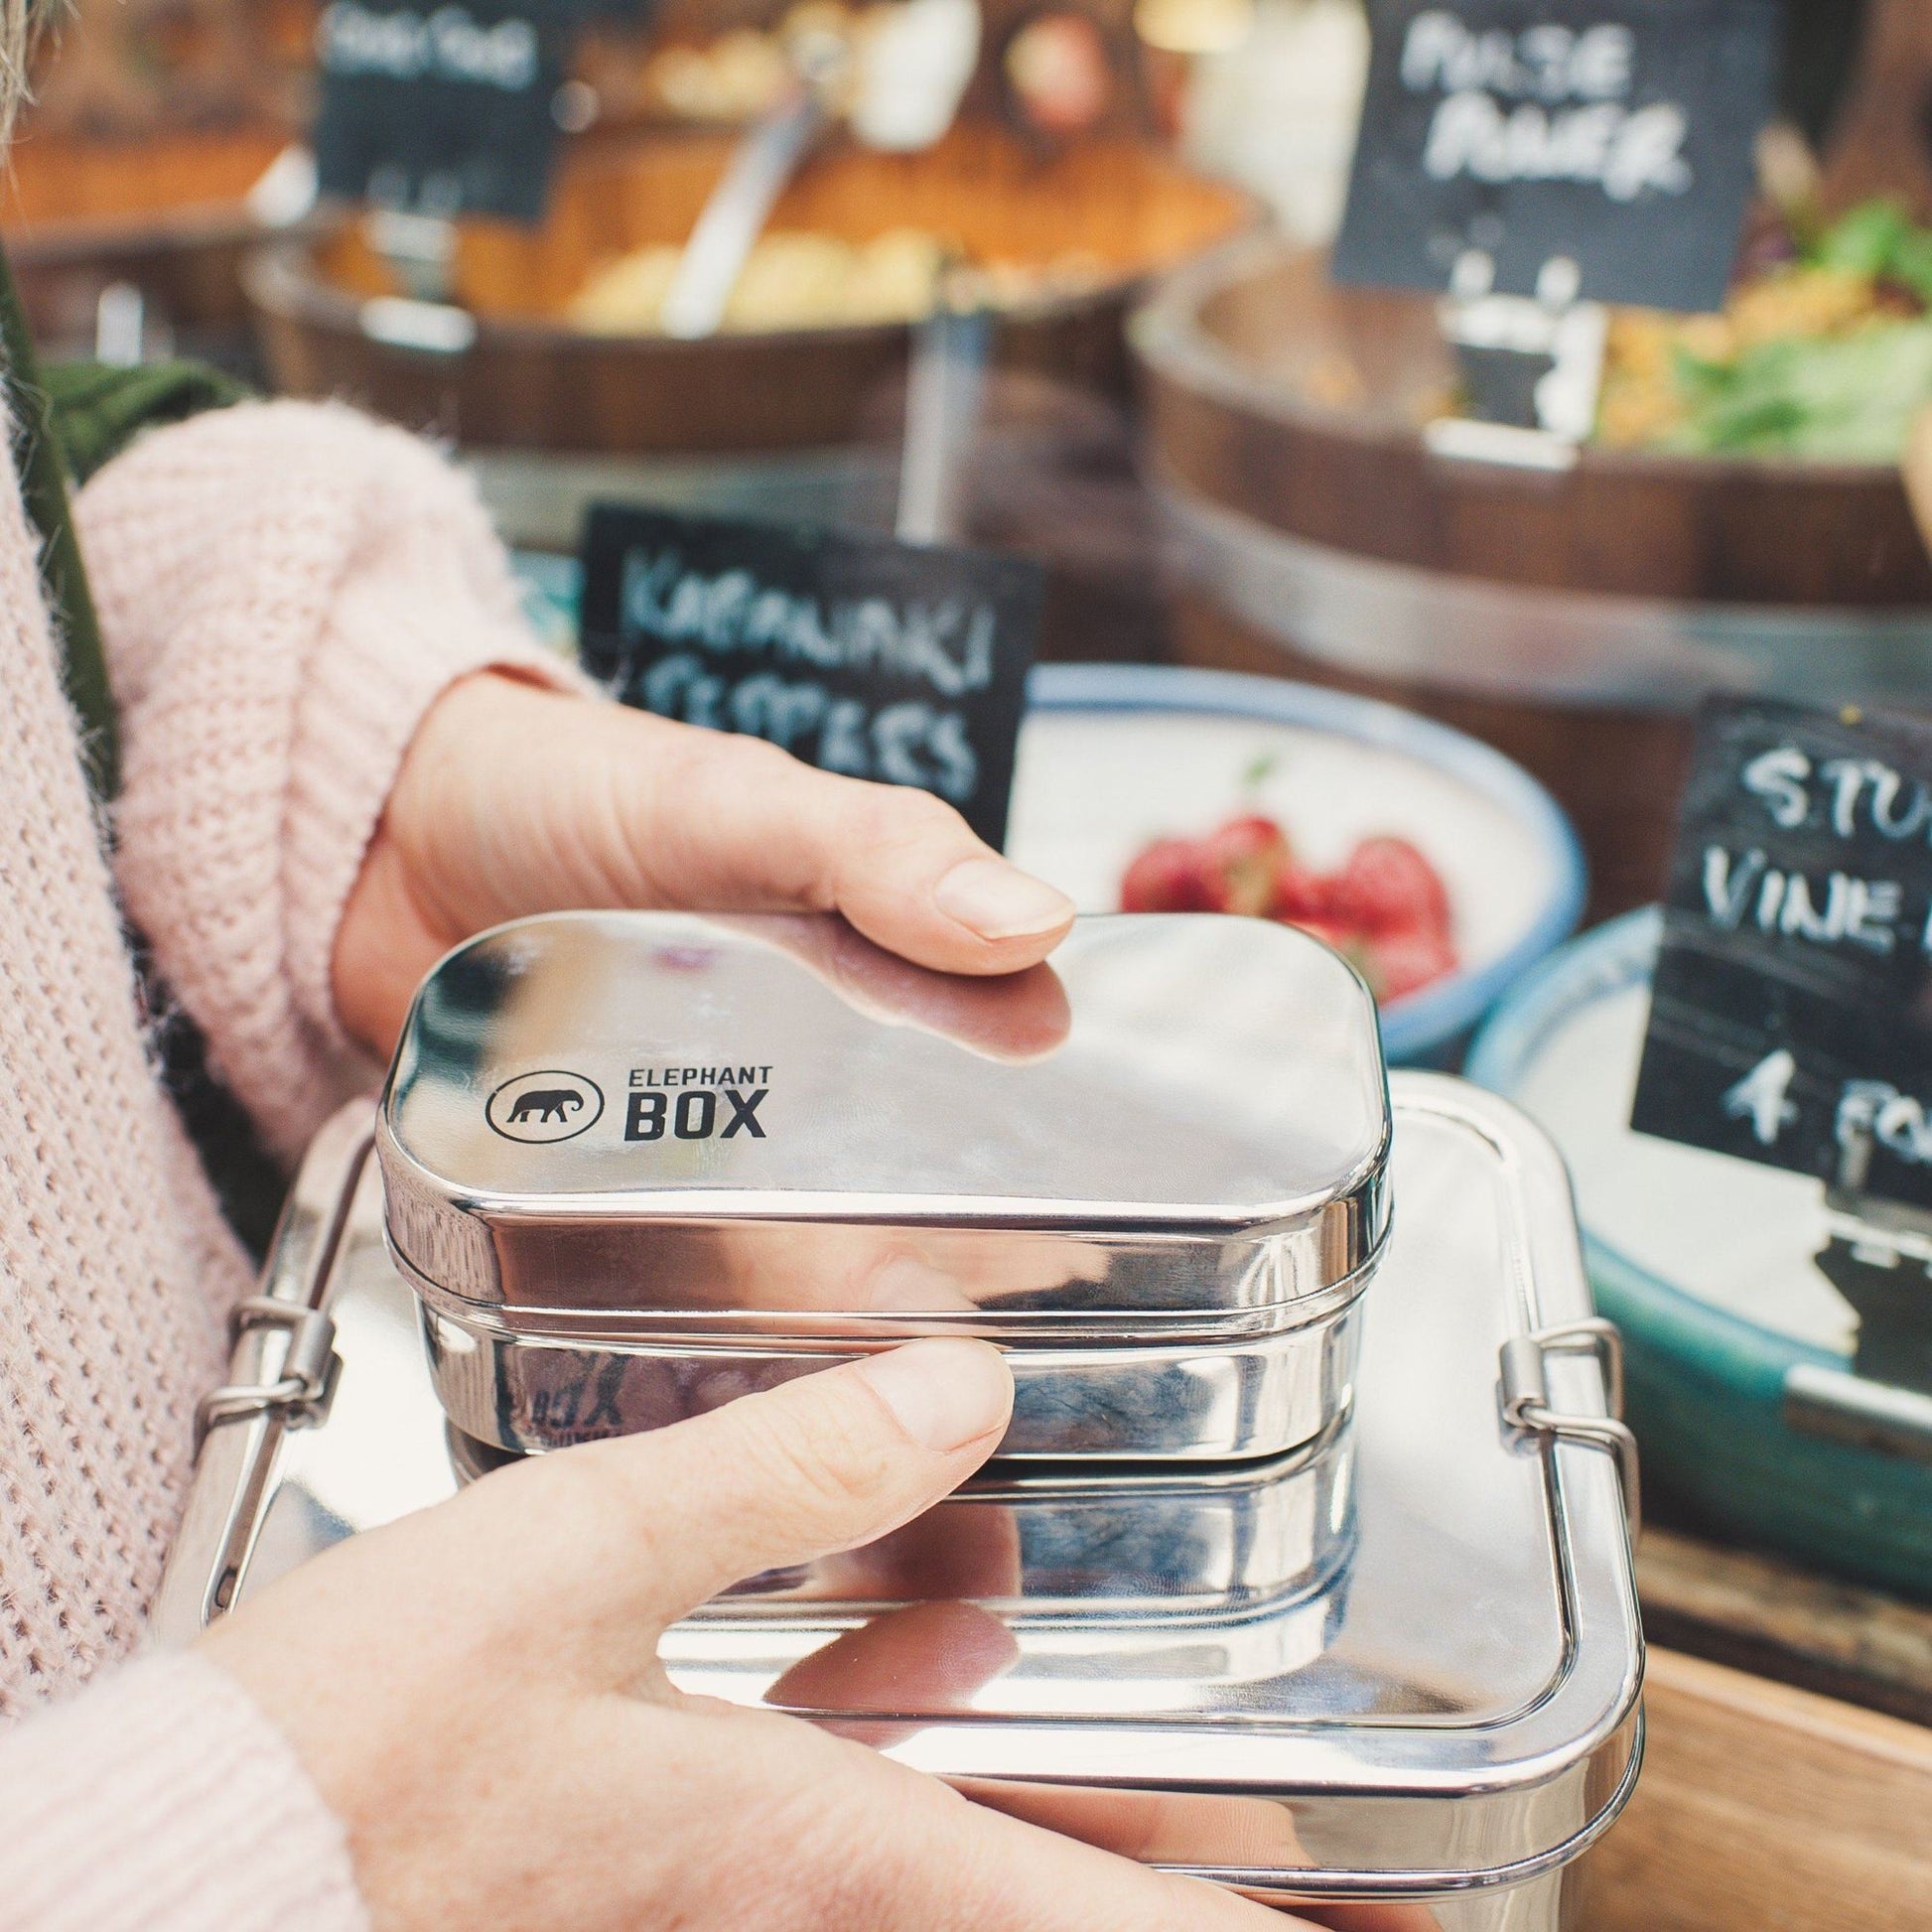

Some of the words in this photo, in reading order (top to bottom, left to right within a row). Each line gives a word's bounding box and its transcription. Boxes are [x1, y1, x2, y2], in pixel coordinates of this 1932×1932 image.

[1744, 747, 1932, 839] STU
[1704, 847, 1902, 955] VINE
[623, 1088, 769, 1142] BOX
[627, 1066, 774, 1088] ELEPHANT
[1724, 1049, 1799, 1145] 4
